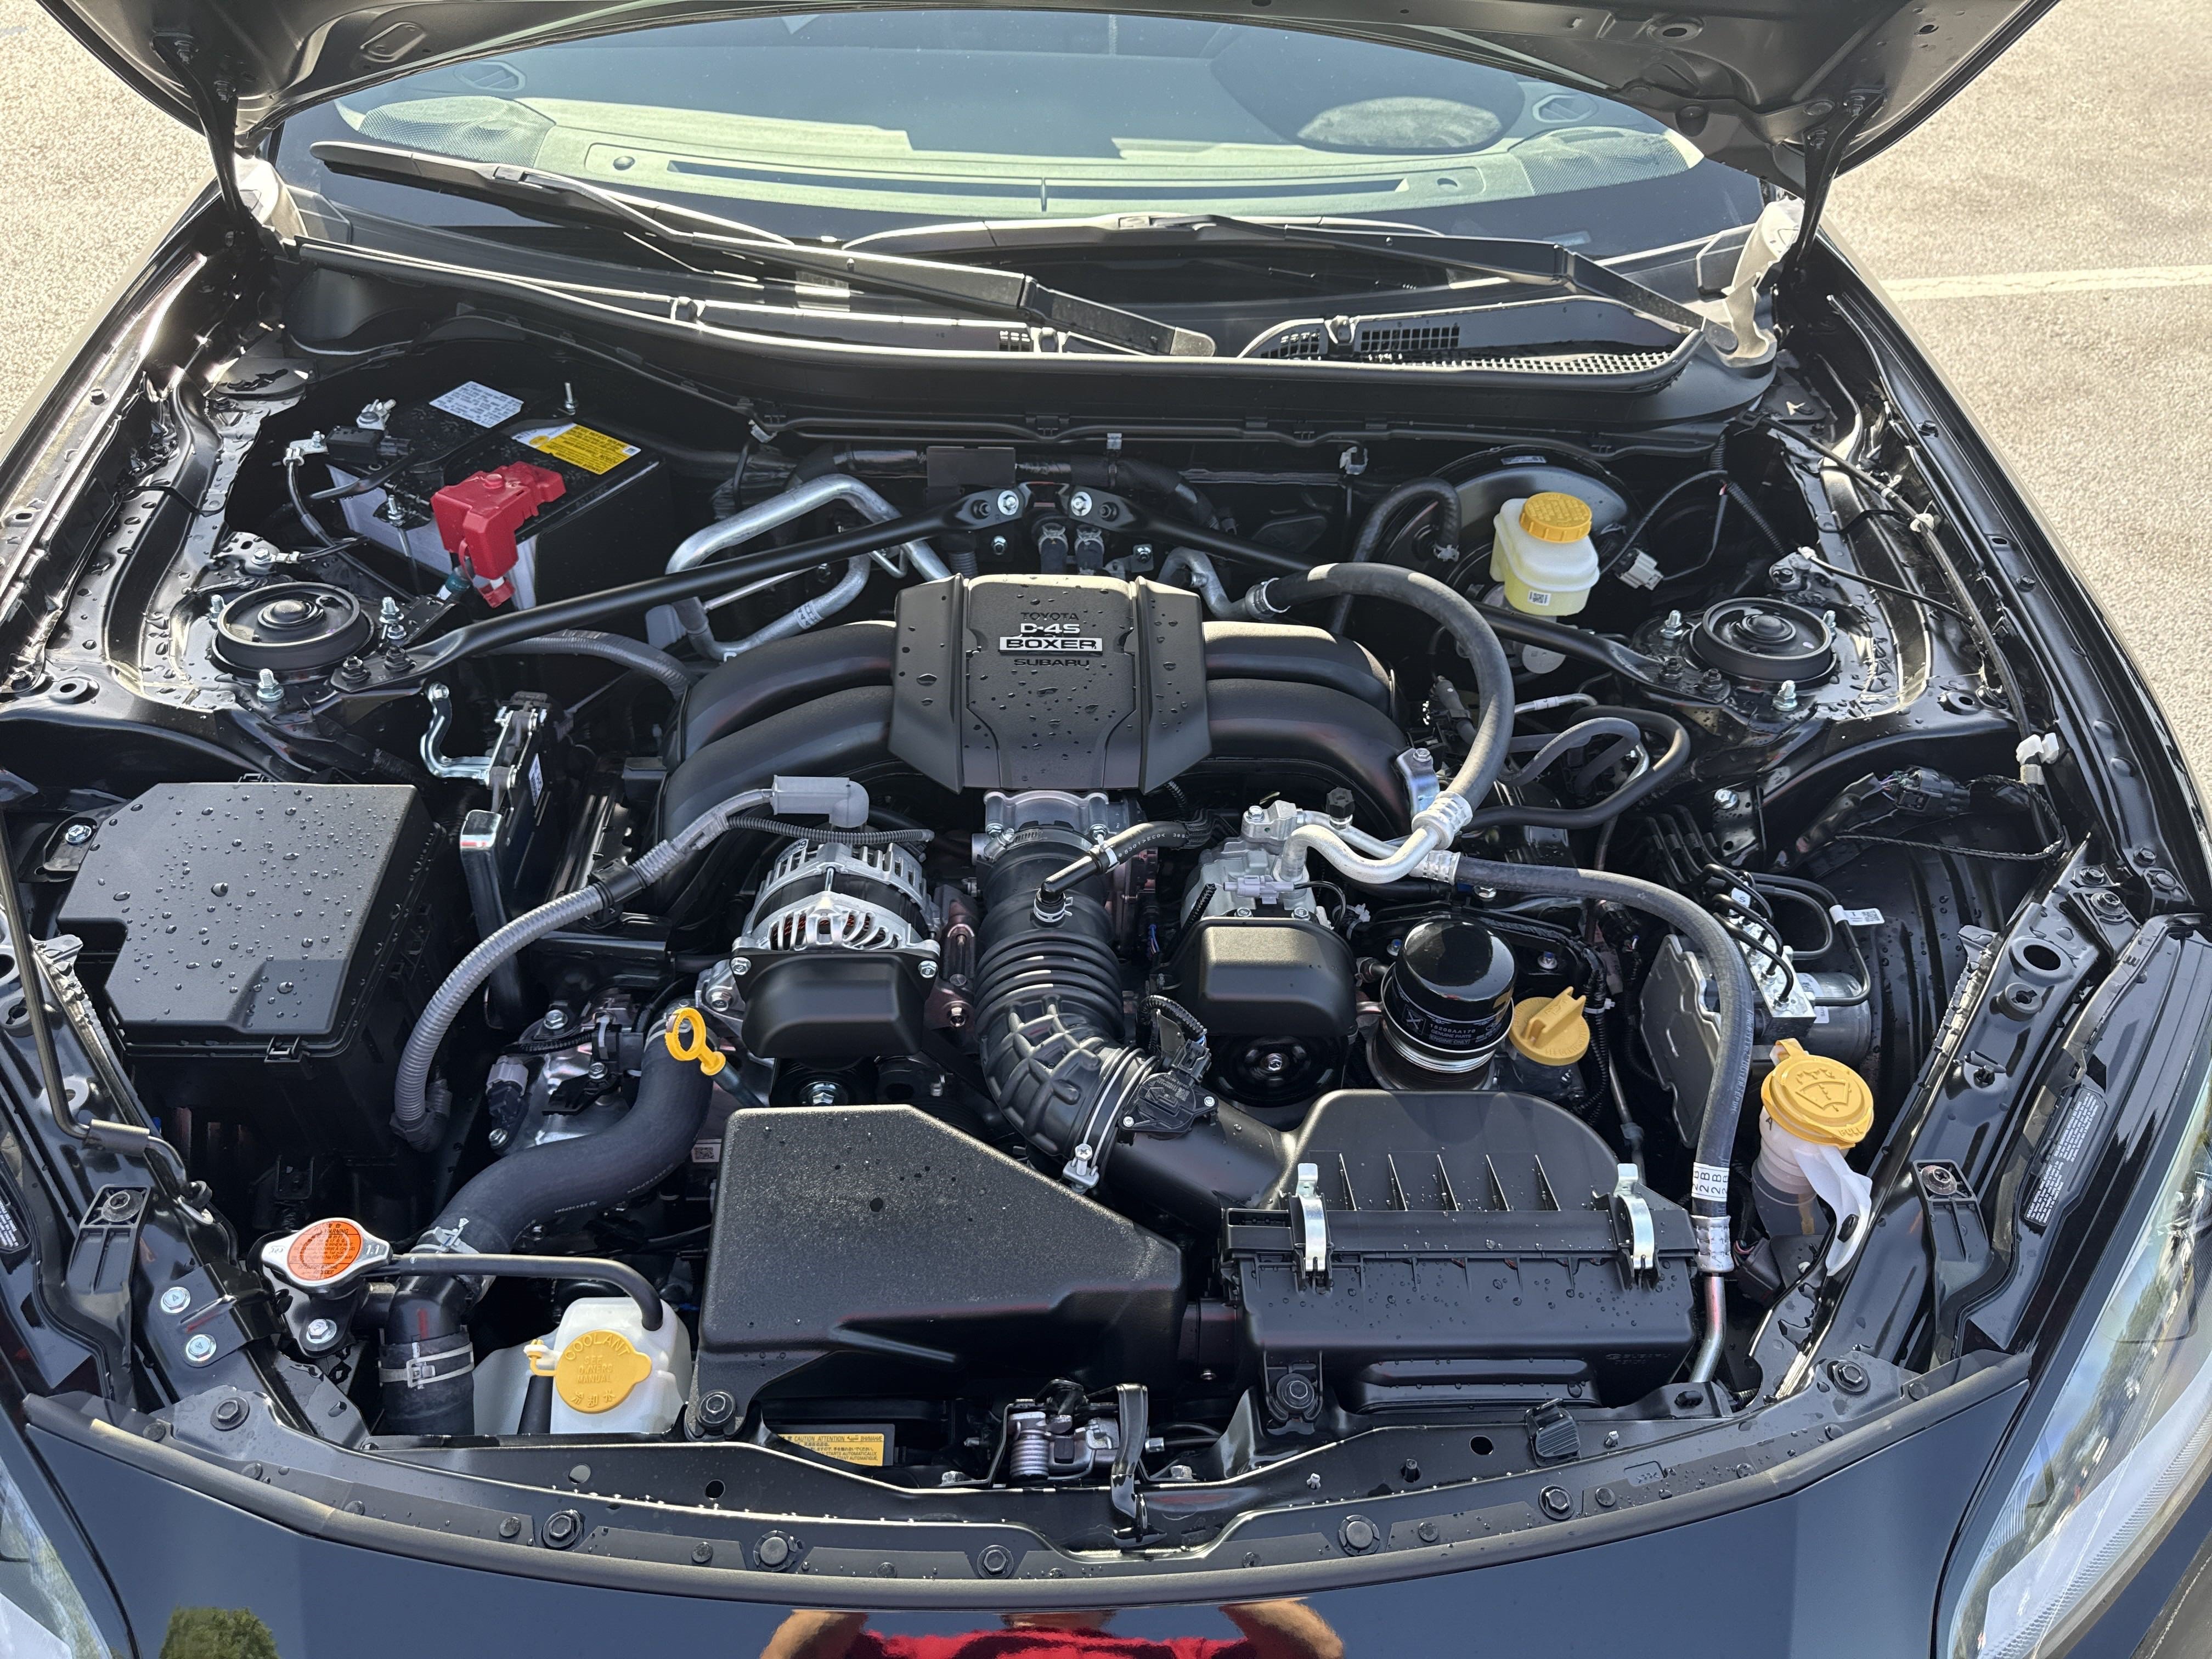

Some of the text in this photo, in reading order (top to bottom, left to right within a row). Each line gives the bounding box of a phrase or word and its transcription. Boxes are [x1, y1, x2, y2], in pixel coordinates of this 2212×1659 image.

[1020, 612, 1079, 620] TOYOTA
[1006, 639, 1097, 649] BOXER
[1839, 1126, 1864, 1136] PULL
[1700, 1172, 1709, 1193] 2B
[1711, 1175, 1721, 1194] 2B
[366, 1245, 380, 1255] 1.1
[565, 1333, 630, 1360] COOLANT
[584, 1355, 603, 1364] SEE
[578, 1363, 612, 1374] OWNERS
[577, 1374, 611, 1383] MANUAL
[571, 1389, 615, 1407] 冷却水
